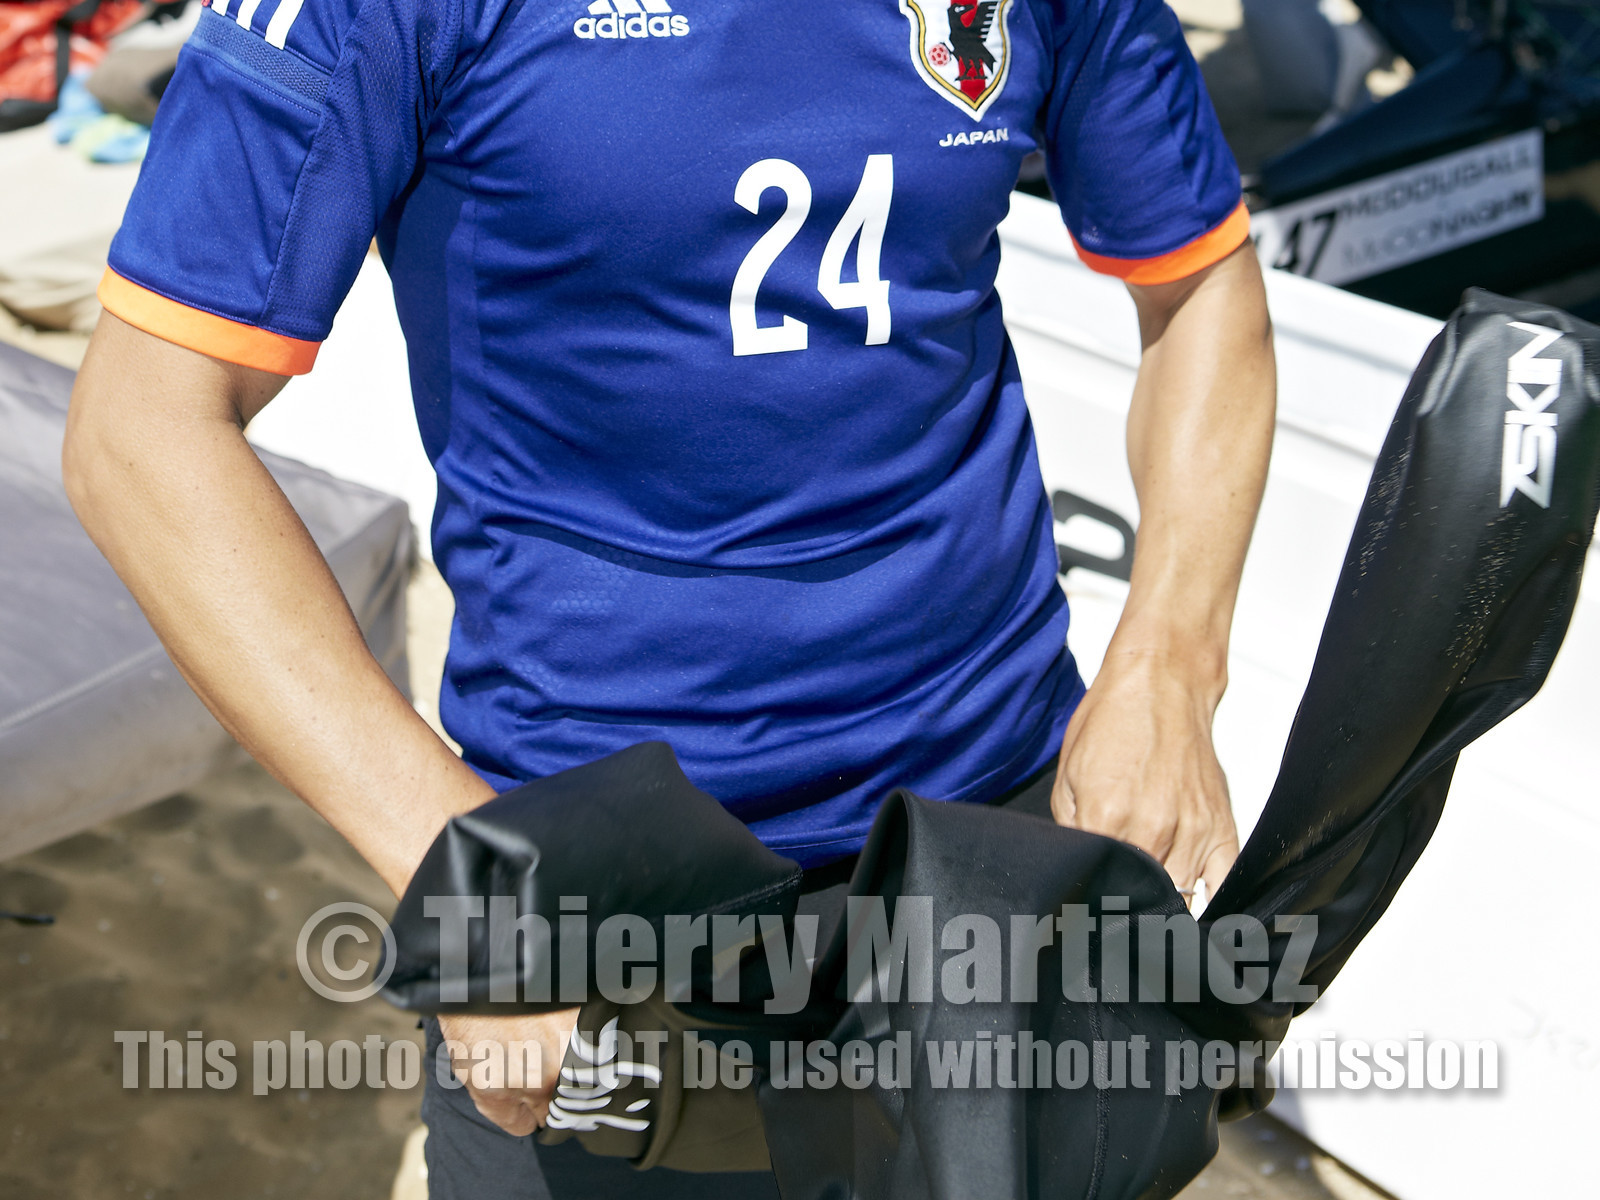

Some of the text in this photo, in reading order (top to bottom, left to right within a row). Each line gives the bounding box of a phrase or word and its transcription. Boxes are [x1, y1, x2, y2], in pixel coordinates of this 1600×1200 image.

[573, 11, 690, 40] adidas
[939, 127, 1010, 148] JAPAN
[729, 154, 894, 357] 24
